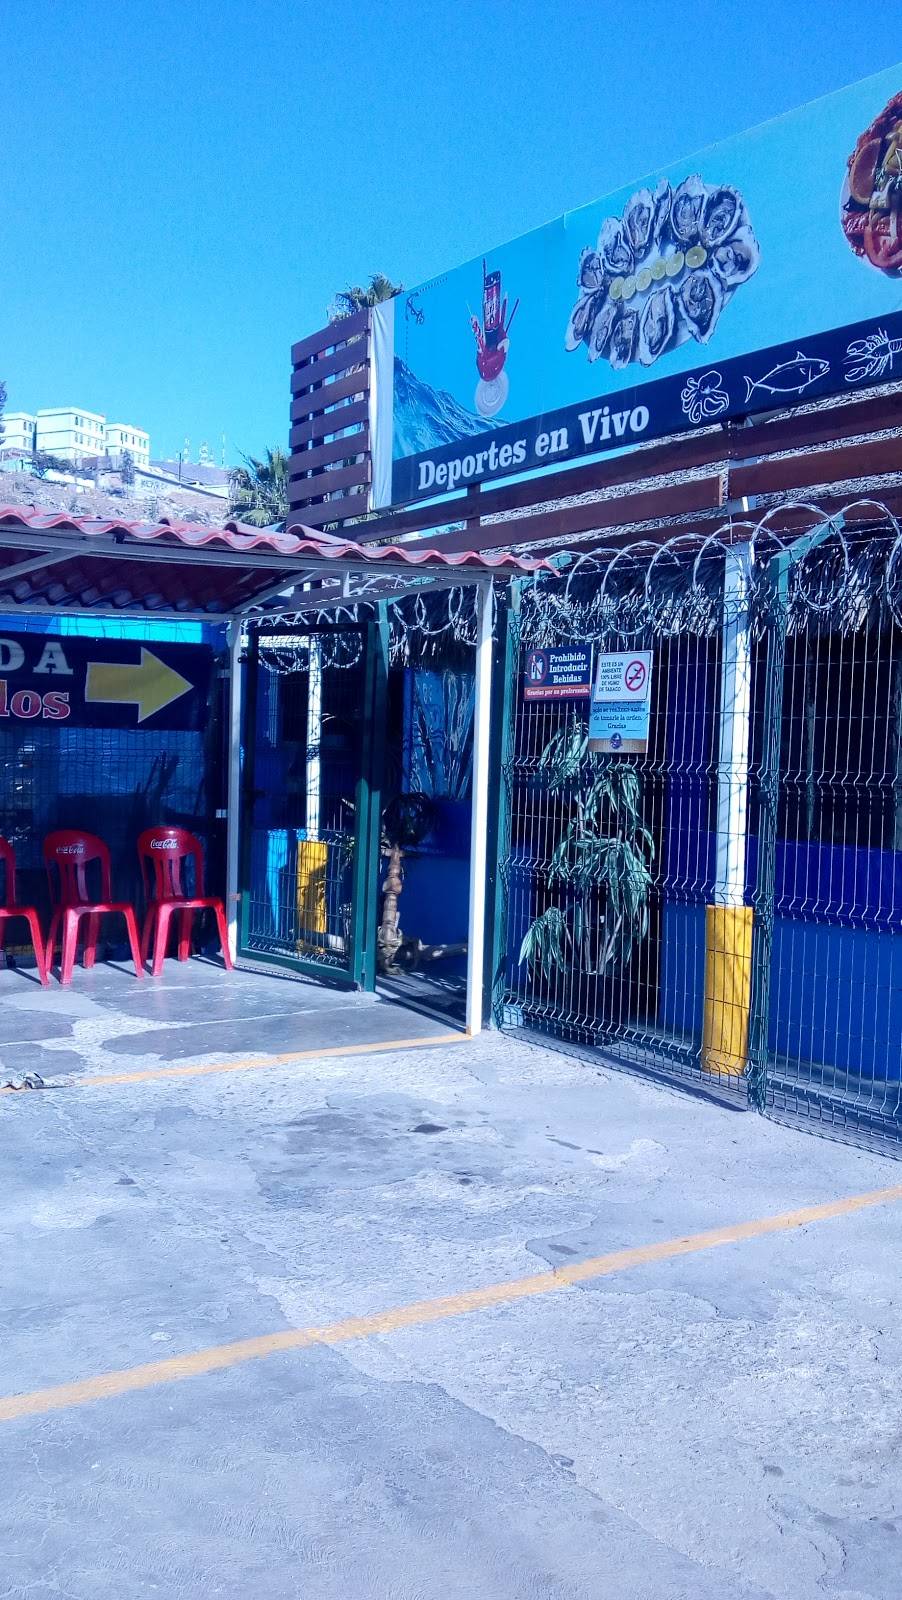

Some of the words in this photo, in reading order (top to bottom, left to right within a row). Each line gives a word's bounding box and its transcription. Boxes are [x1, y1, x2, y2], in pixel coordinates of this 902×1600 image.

[418, 437, 527, 490] Deportes
[535, 427, 569, 457] en
[578, 405, 650, 445] Vivo
[550, 652, 586, 663] Prohibido
[549, 662, 588, 673] Introducir
[553, 673, 582, 684] Bebidas
